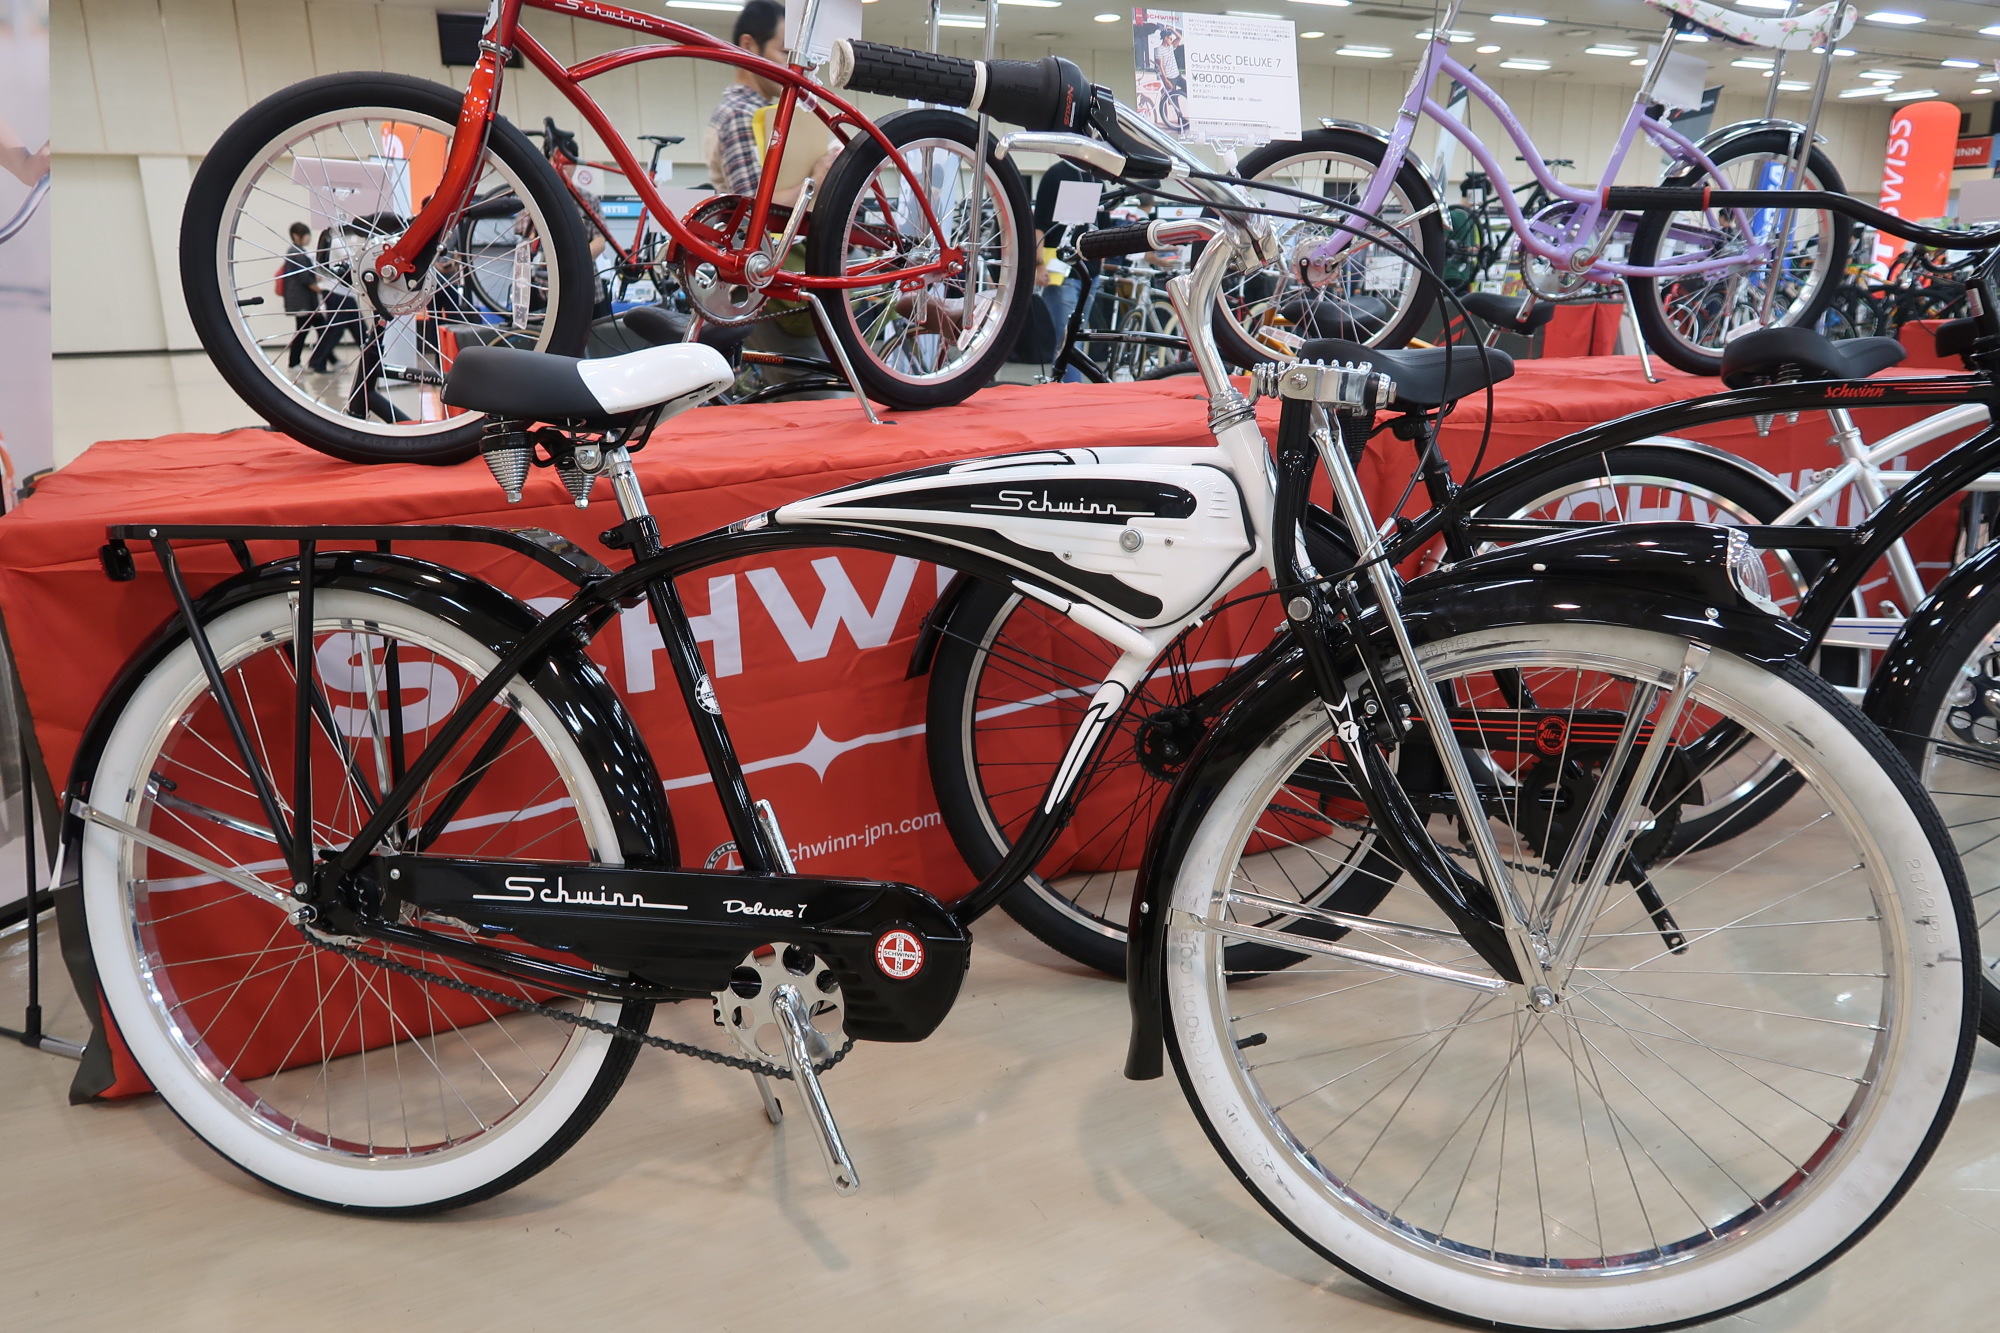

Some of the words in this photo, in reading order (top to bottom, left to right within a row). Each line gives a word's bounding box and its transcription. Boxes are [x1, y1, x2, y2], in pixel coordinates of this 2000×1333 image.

[555, 0, 653, 29] Schwinn
[1190, 52, 1232, 65] CLASSIC
[1235, 55, 1273, 68] DELUXE
[1275, 58, 1282, 68] 7
[1192, 73, 1235, 84] ¥90,000
[970, 490, 1155, 516] Schwinn
[1342, 724, 1352, 740] 7
[472, 876, 688, 910] Schwinn
[722, 900, 794, 918] Deluxe
[797, 903, 808, 919] 7
[884, 950, 915, 959] SCHWINN
